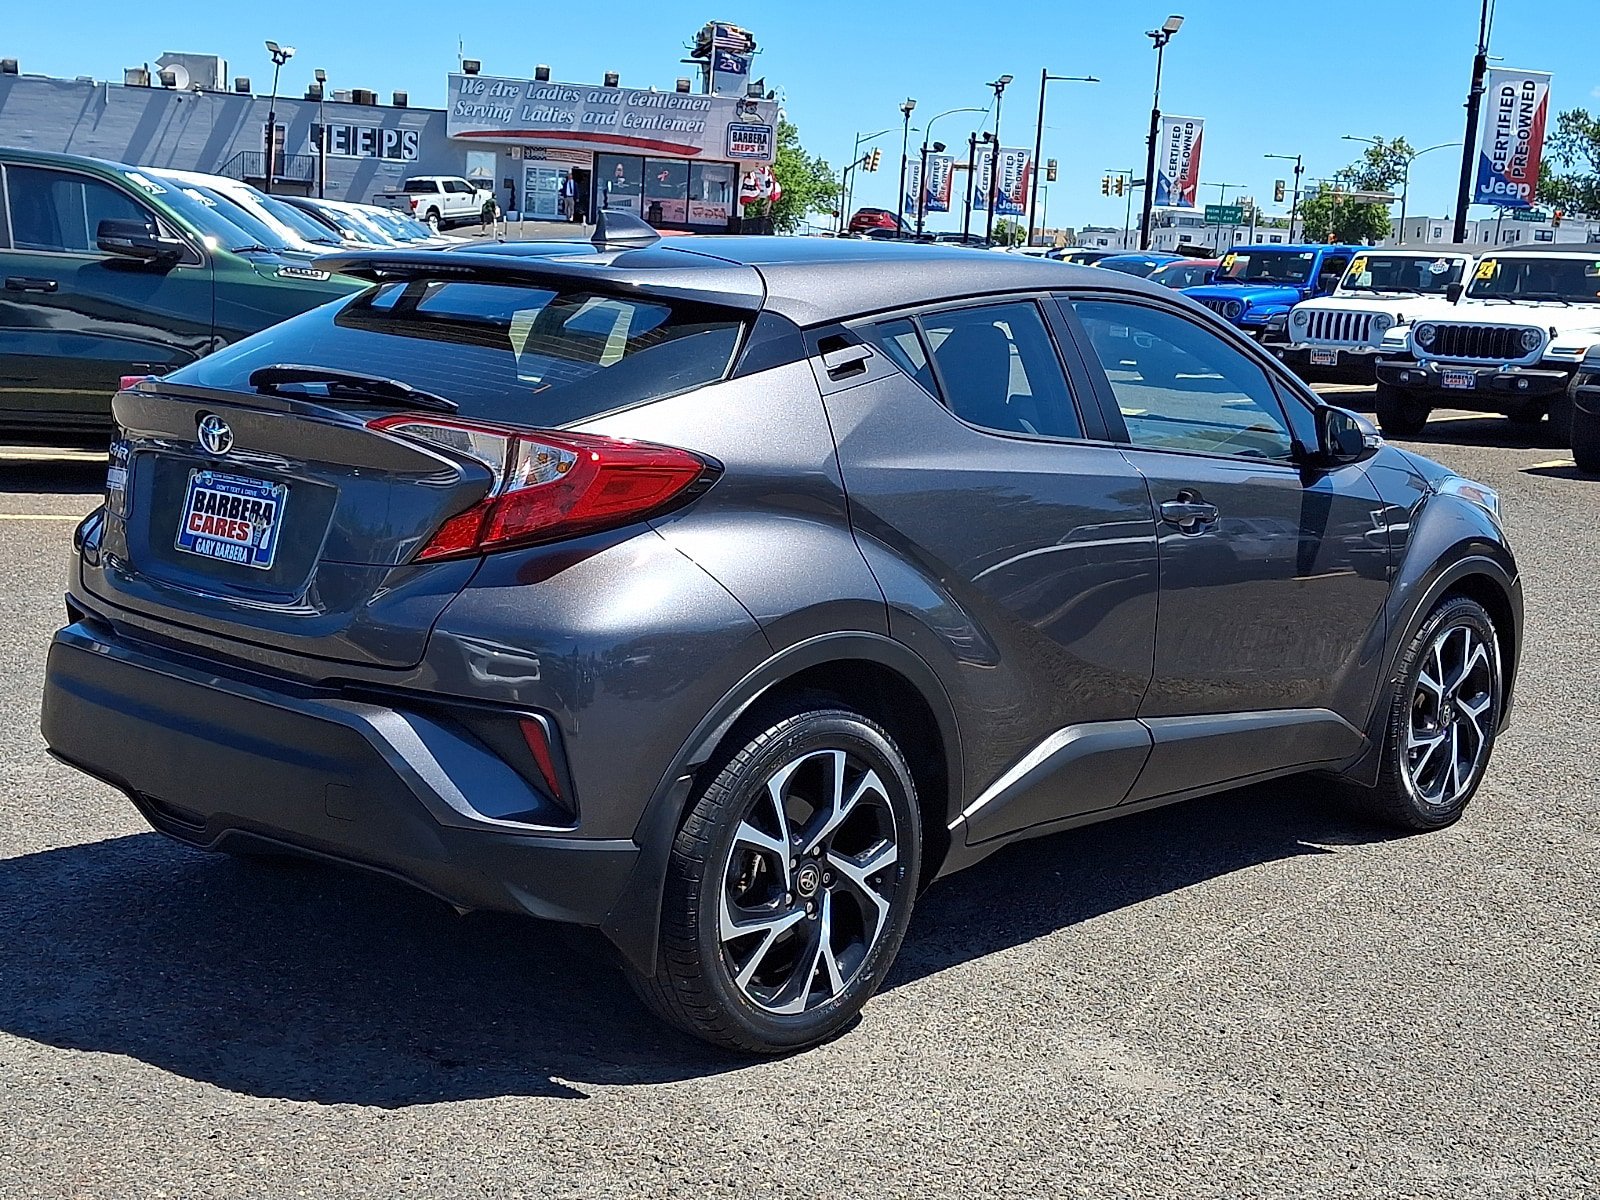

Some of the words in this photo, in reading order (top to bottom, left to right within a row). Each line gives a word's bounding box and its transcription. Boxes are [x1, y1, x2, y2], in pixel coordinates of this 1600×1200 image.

[460, 79, 485, 95] We
[490, 81, 519, 98] Are
[526, 83, 580, 102] Ladies
[587, 90, 624, 105] and
[627, 91, 712, 111] Gentlemen
[454, 100, 514, 123] Serving
[521, 105, 575, 124] Ladies
[582, 110, 619, 125] and
[622, 112, 706, 132] Gentlemen
[1493, 86, 1515, 174] CERTIFIED
[1512, 80, 1536, 178] PRE-OWNED
[731, 143, 756, 152] JEEPS
[732, 131, 768, 145] BARBERA
[1168, 125, 1181, 178] CERTIFIED
[1180, 122, 1194, 181] PRE-OWNED
[1004, 155, 1014, 199] CERTIFIED
[1014, 151, 1025, 201] PRE-OWNED
[1480, 176, 1531, 199] Jeep
[998, 200, 1024, 212] Jeep
[193, 490, 274, 525] BARBERA
[189, 513, 250, 541] CARES
[195, 538, 216, 555] GARY
[214, 543, 248, 563] BARBERA
